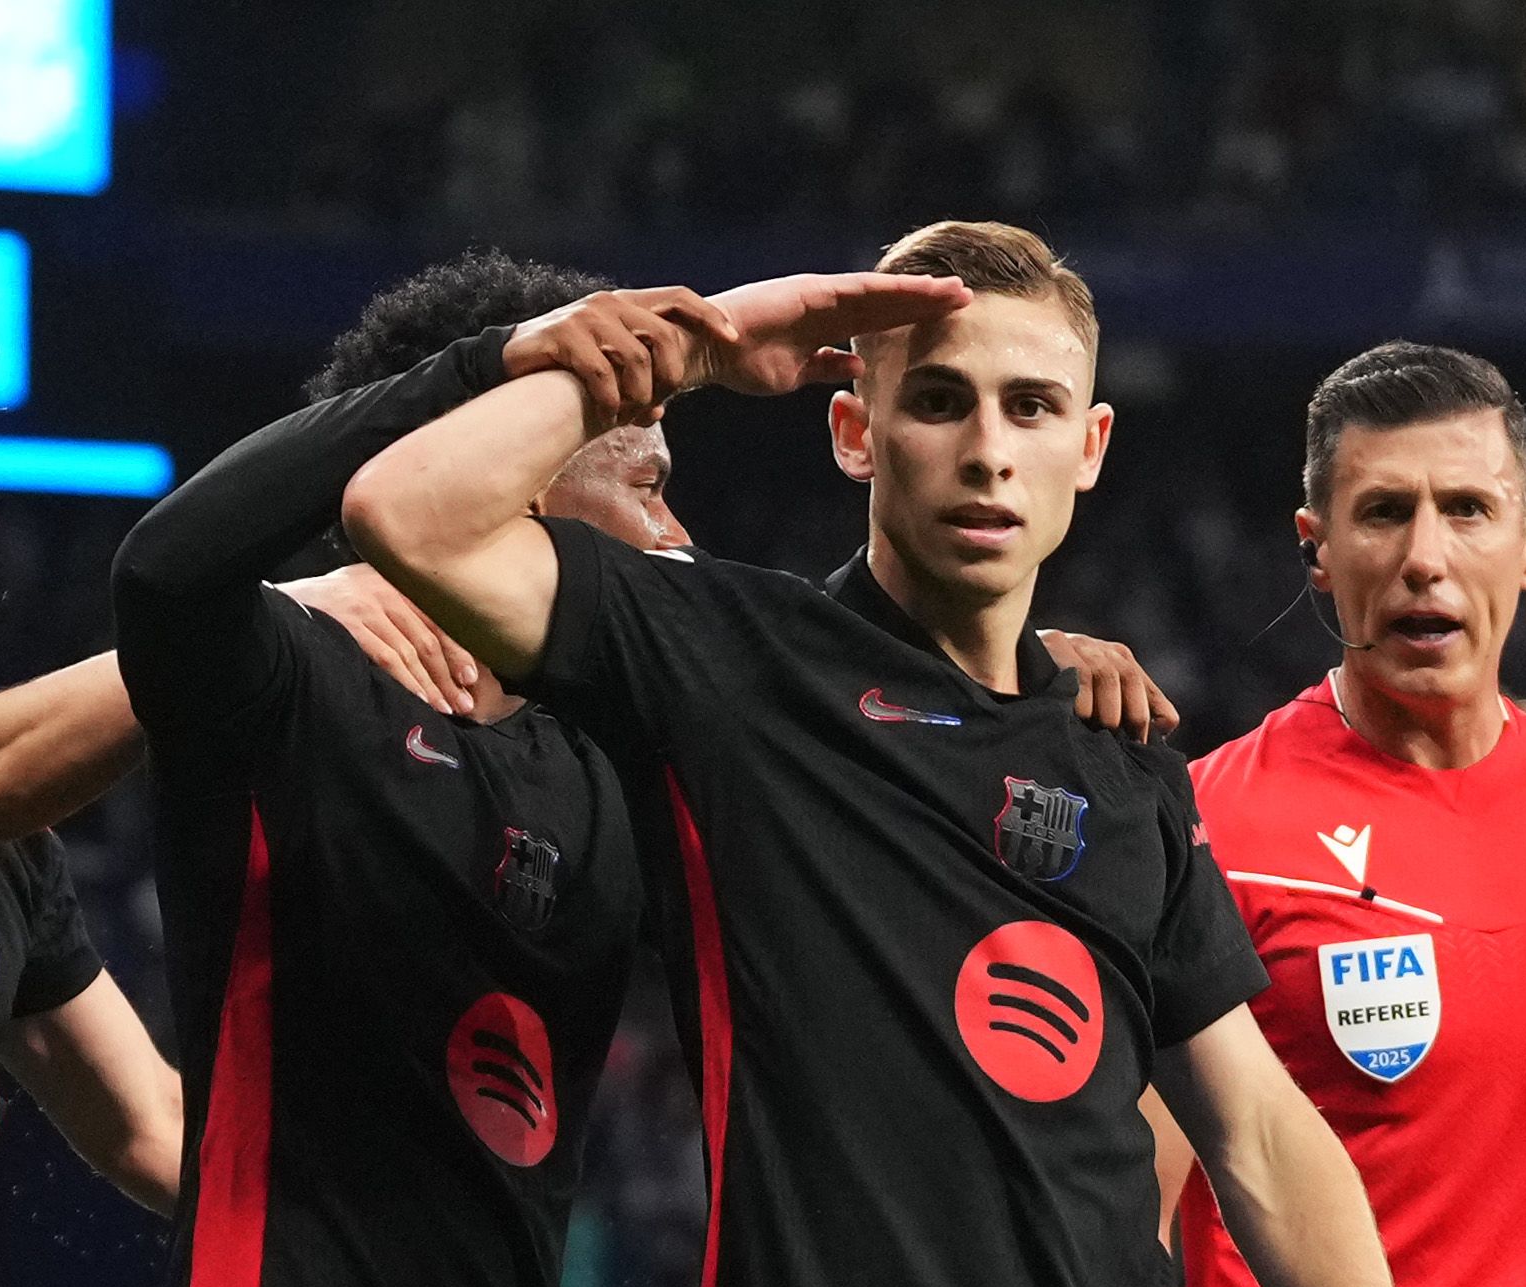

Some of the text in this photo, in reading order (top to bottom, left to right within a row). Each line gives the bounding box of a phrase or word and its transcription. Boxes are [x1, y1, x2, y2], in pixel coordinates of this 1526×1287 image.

[1331, 946, 1425, 986] FIFA
[1337, 1000, 1430, 1027] REFEREE
[1366, 1048, 1412, 1069] 2025
